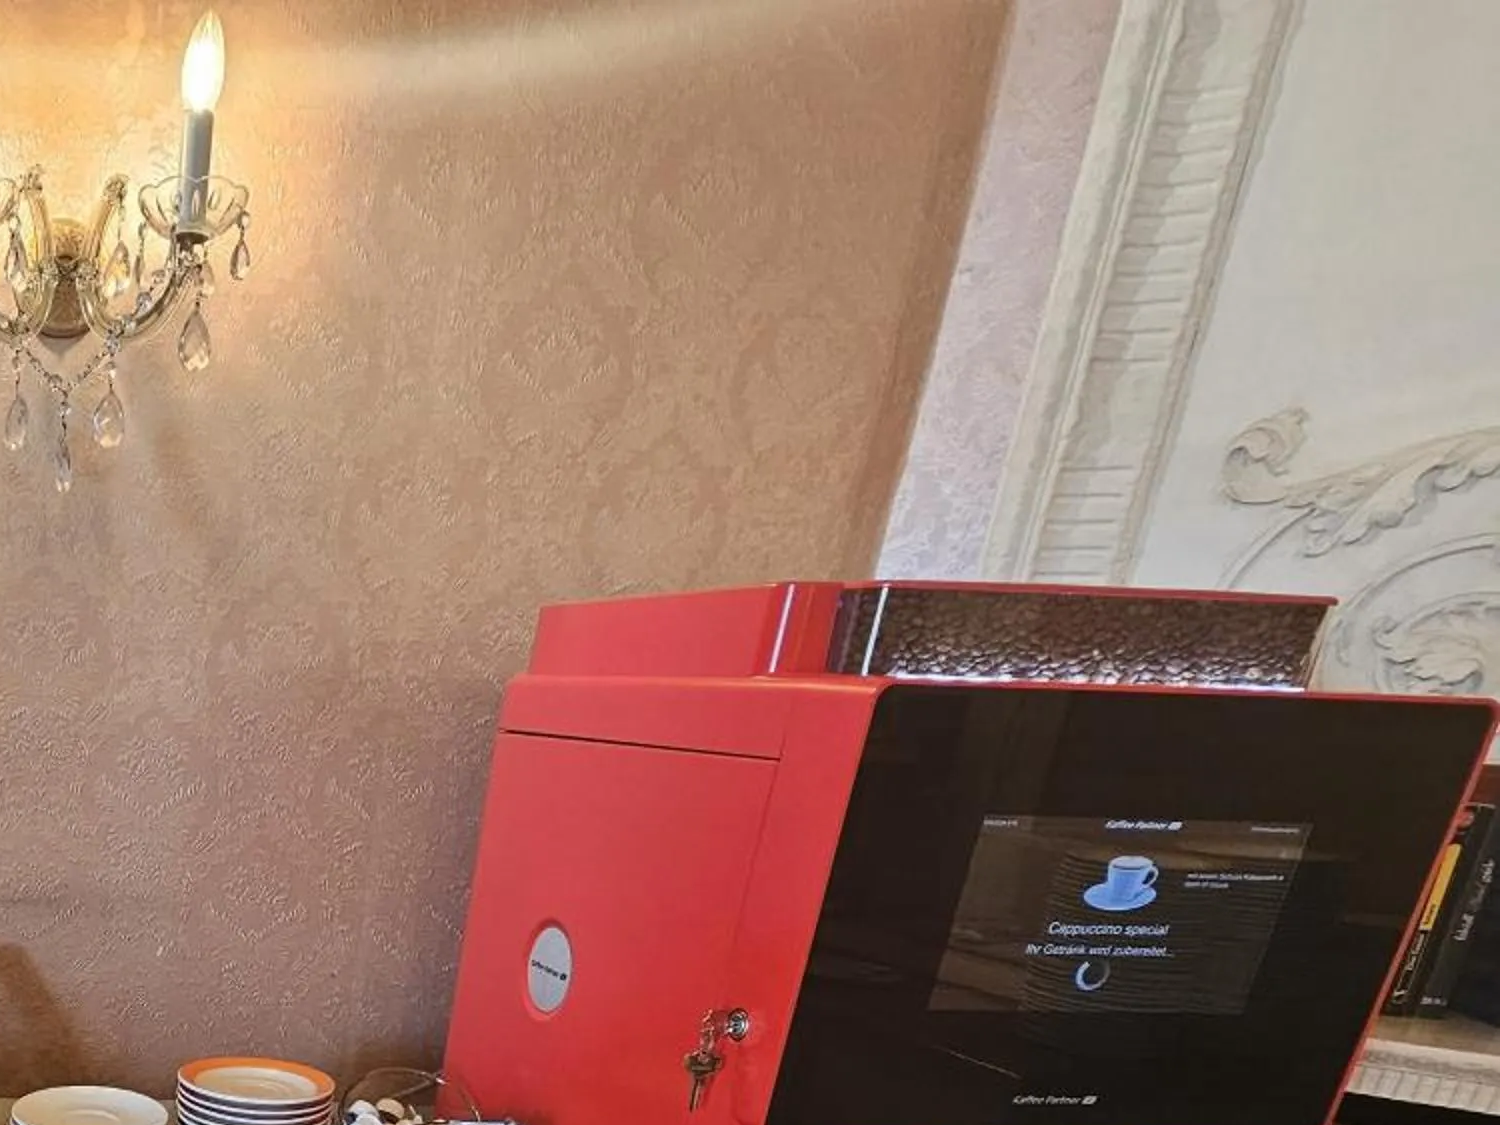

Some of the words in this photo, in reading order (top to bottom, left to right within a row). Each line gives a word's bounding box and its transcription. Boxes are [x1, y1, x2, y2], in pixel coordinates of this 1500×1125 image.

[1048, 921, 1123, 937] Cappuccino
[1124, 923, 1171, 938] special
[1088, 945, 1111, 956] wird
